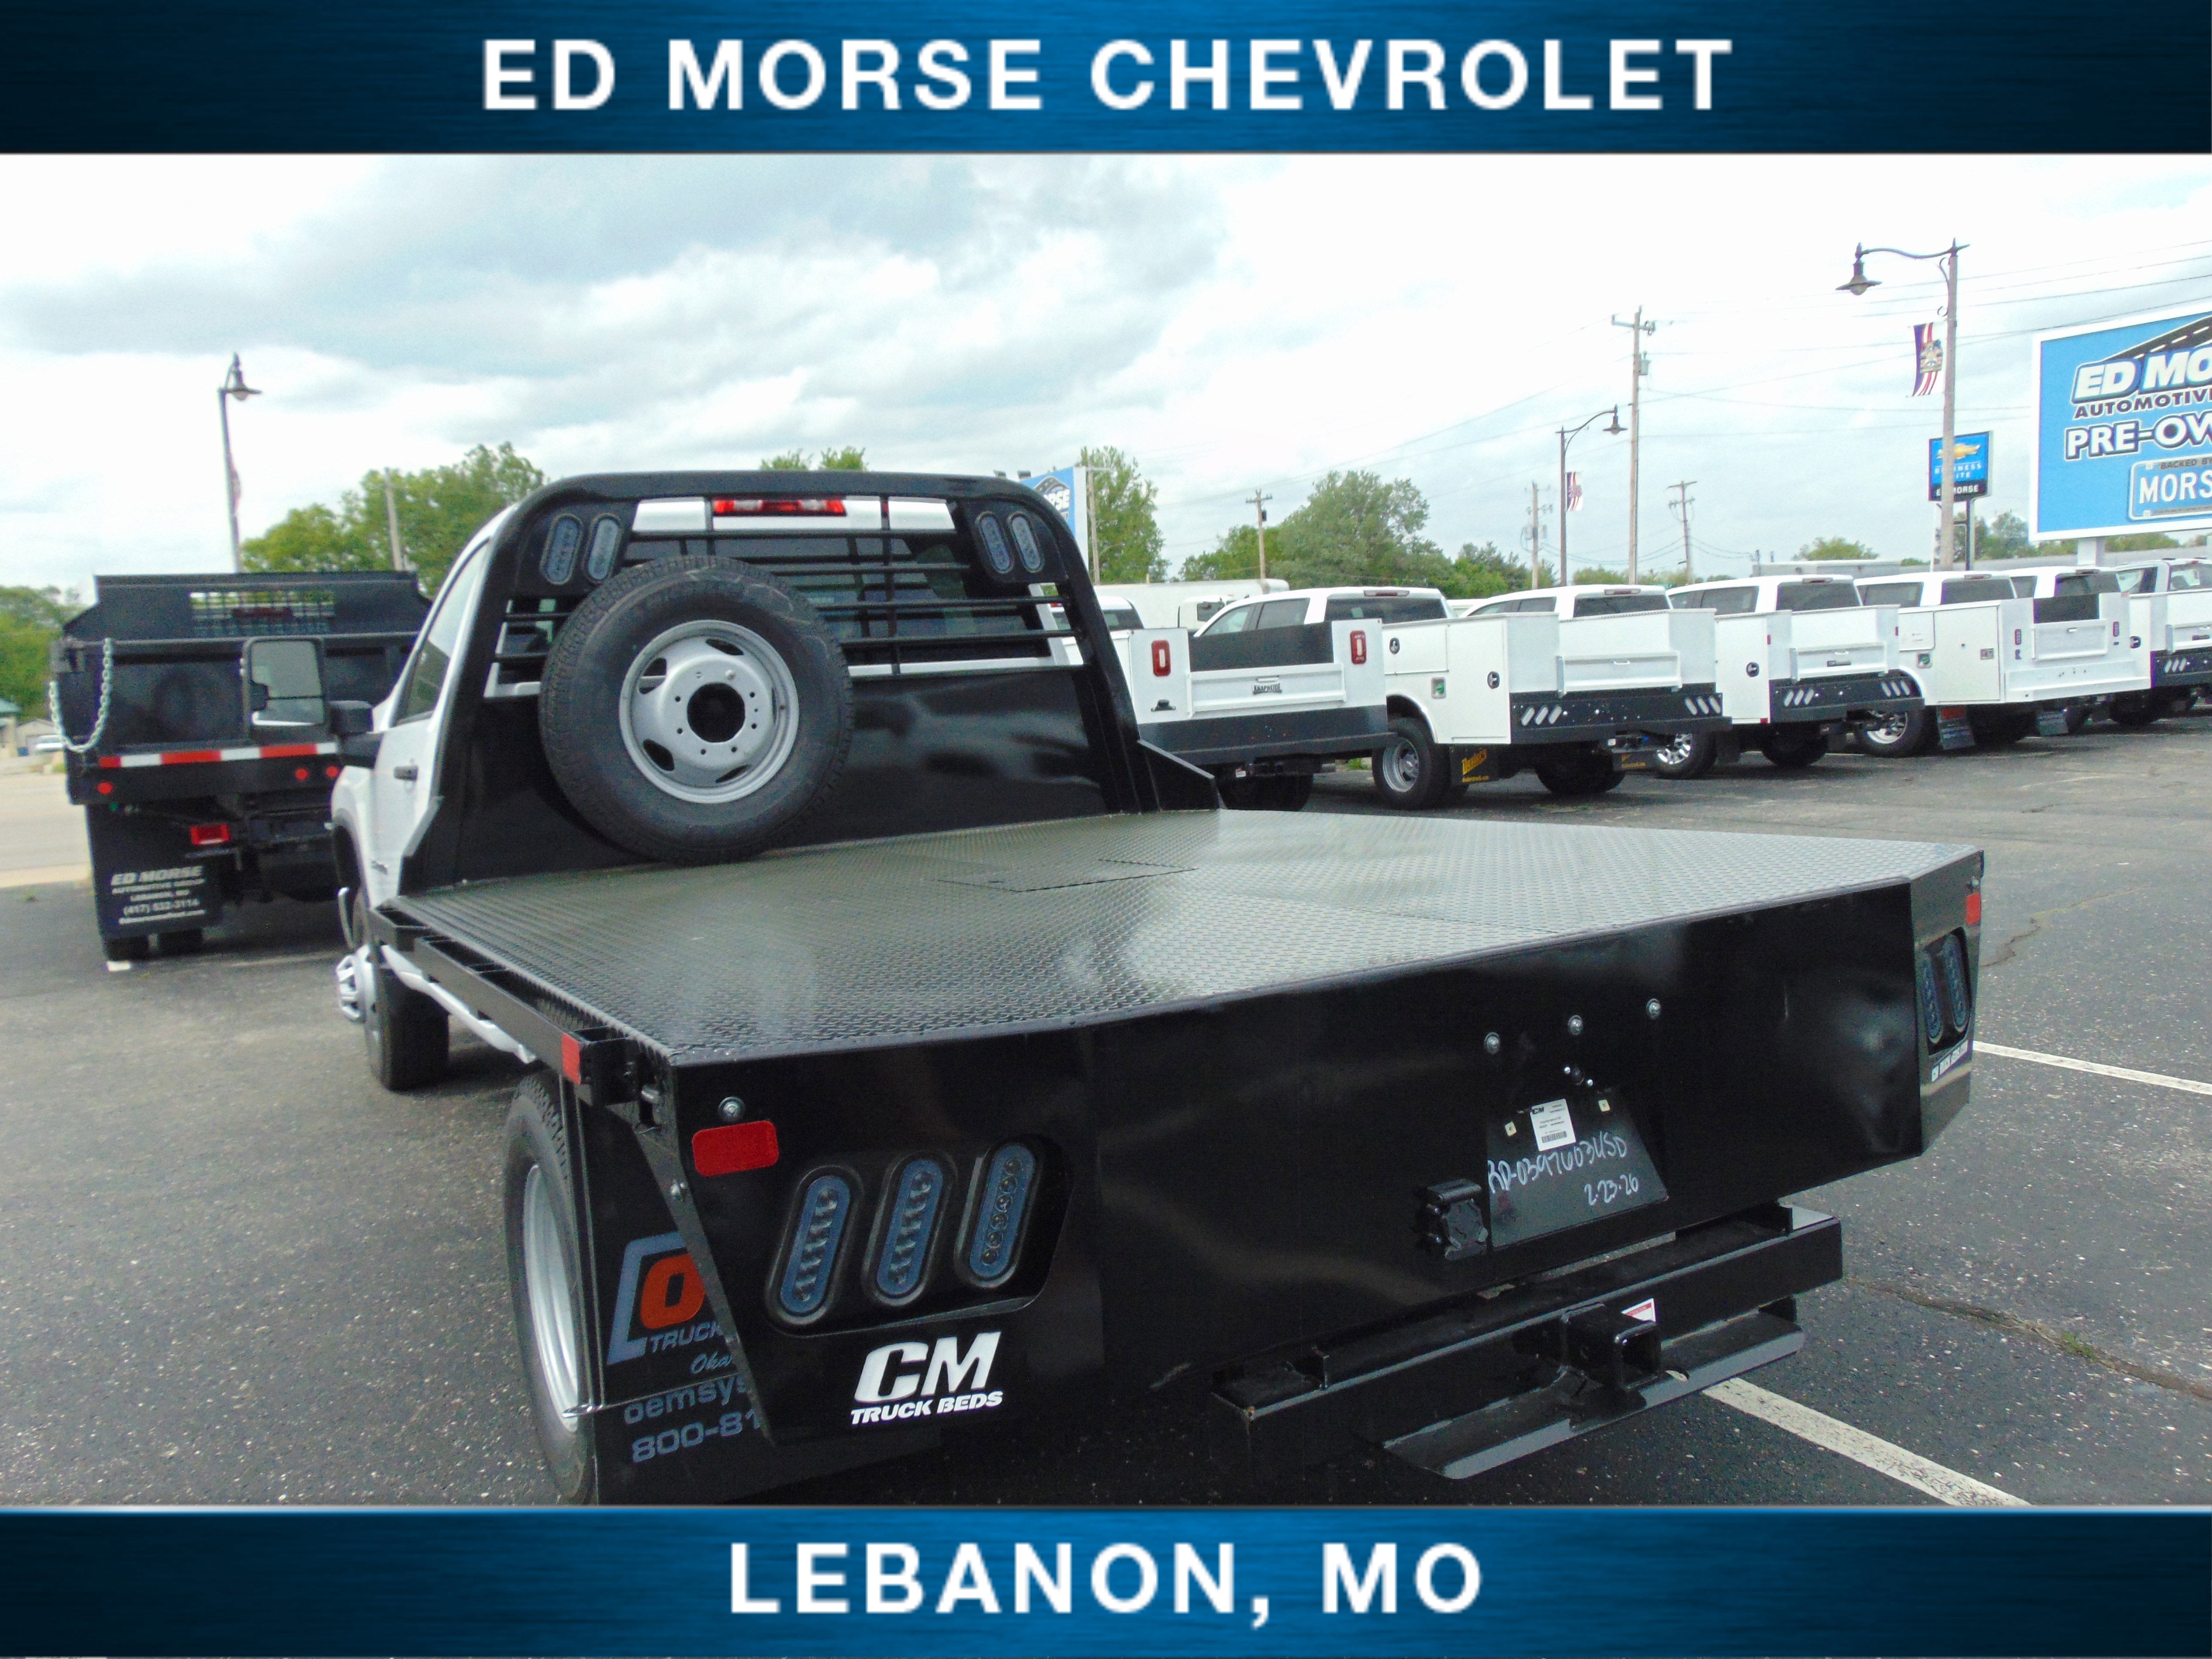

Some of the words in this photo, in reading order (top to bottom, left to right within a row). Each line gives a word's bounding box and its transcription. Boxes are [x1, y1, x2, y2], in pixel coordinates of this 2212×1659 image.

[2074, 361, 2136, 399] ED
[2142, 347, 2212, 389] MO
[1934, 463, 1981, 474] BINESS
[2160, 459, 2197, 470] BACKED
[2139, 470, 2212, 504] MORS
[854, 1331, 1001, 1403] CM
[851, 1399, 933, 1425] TRUCK
[936, 1390, 1004, 1414] BEDS
